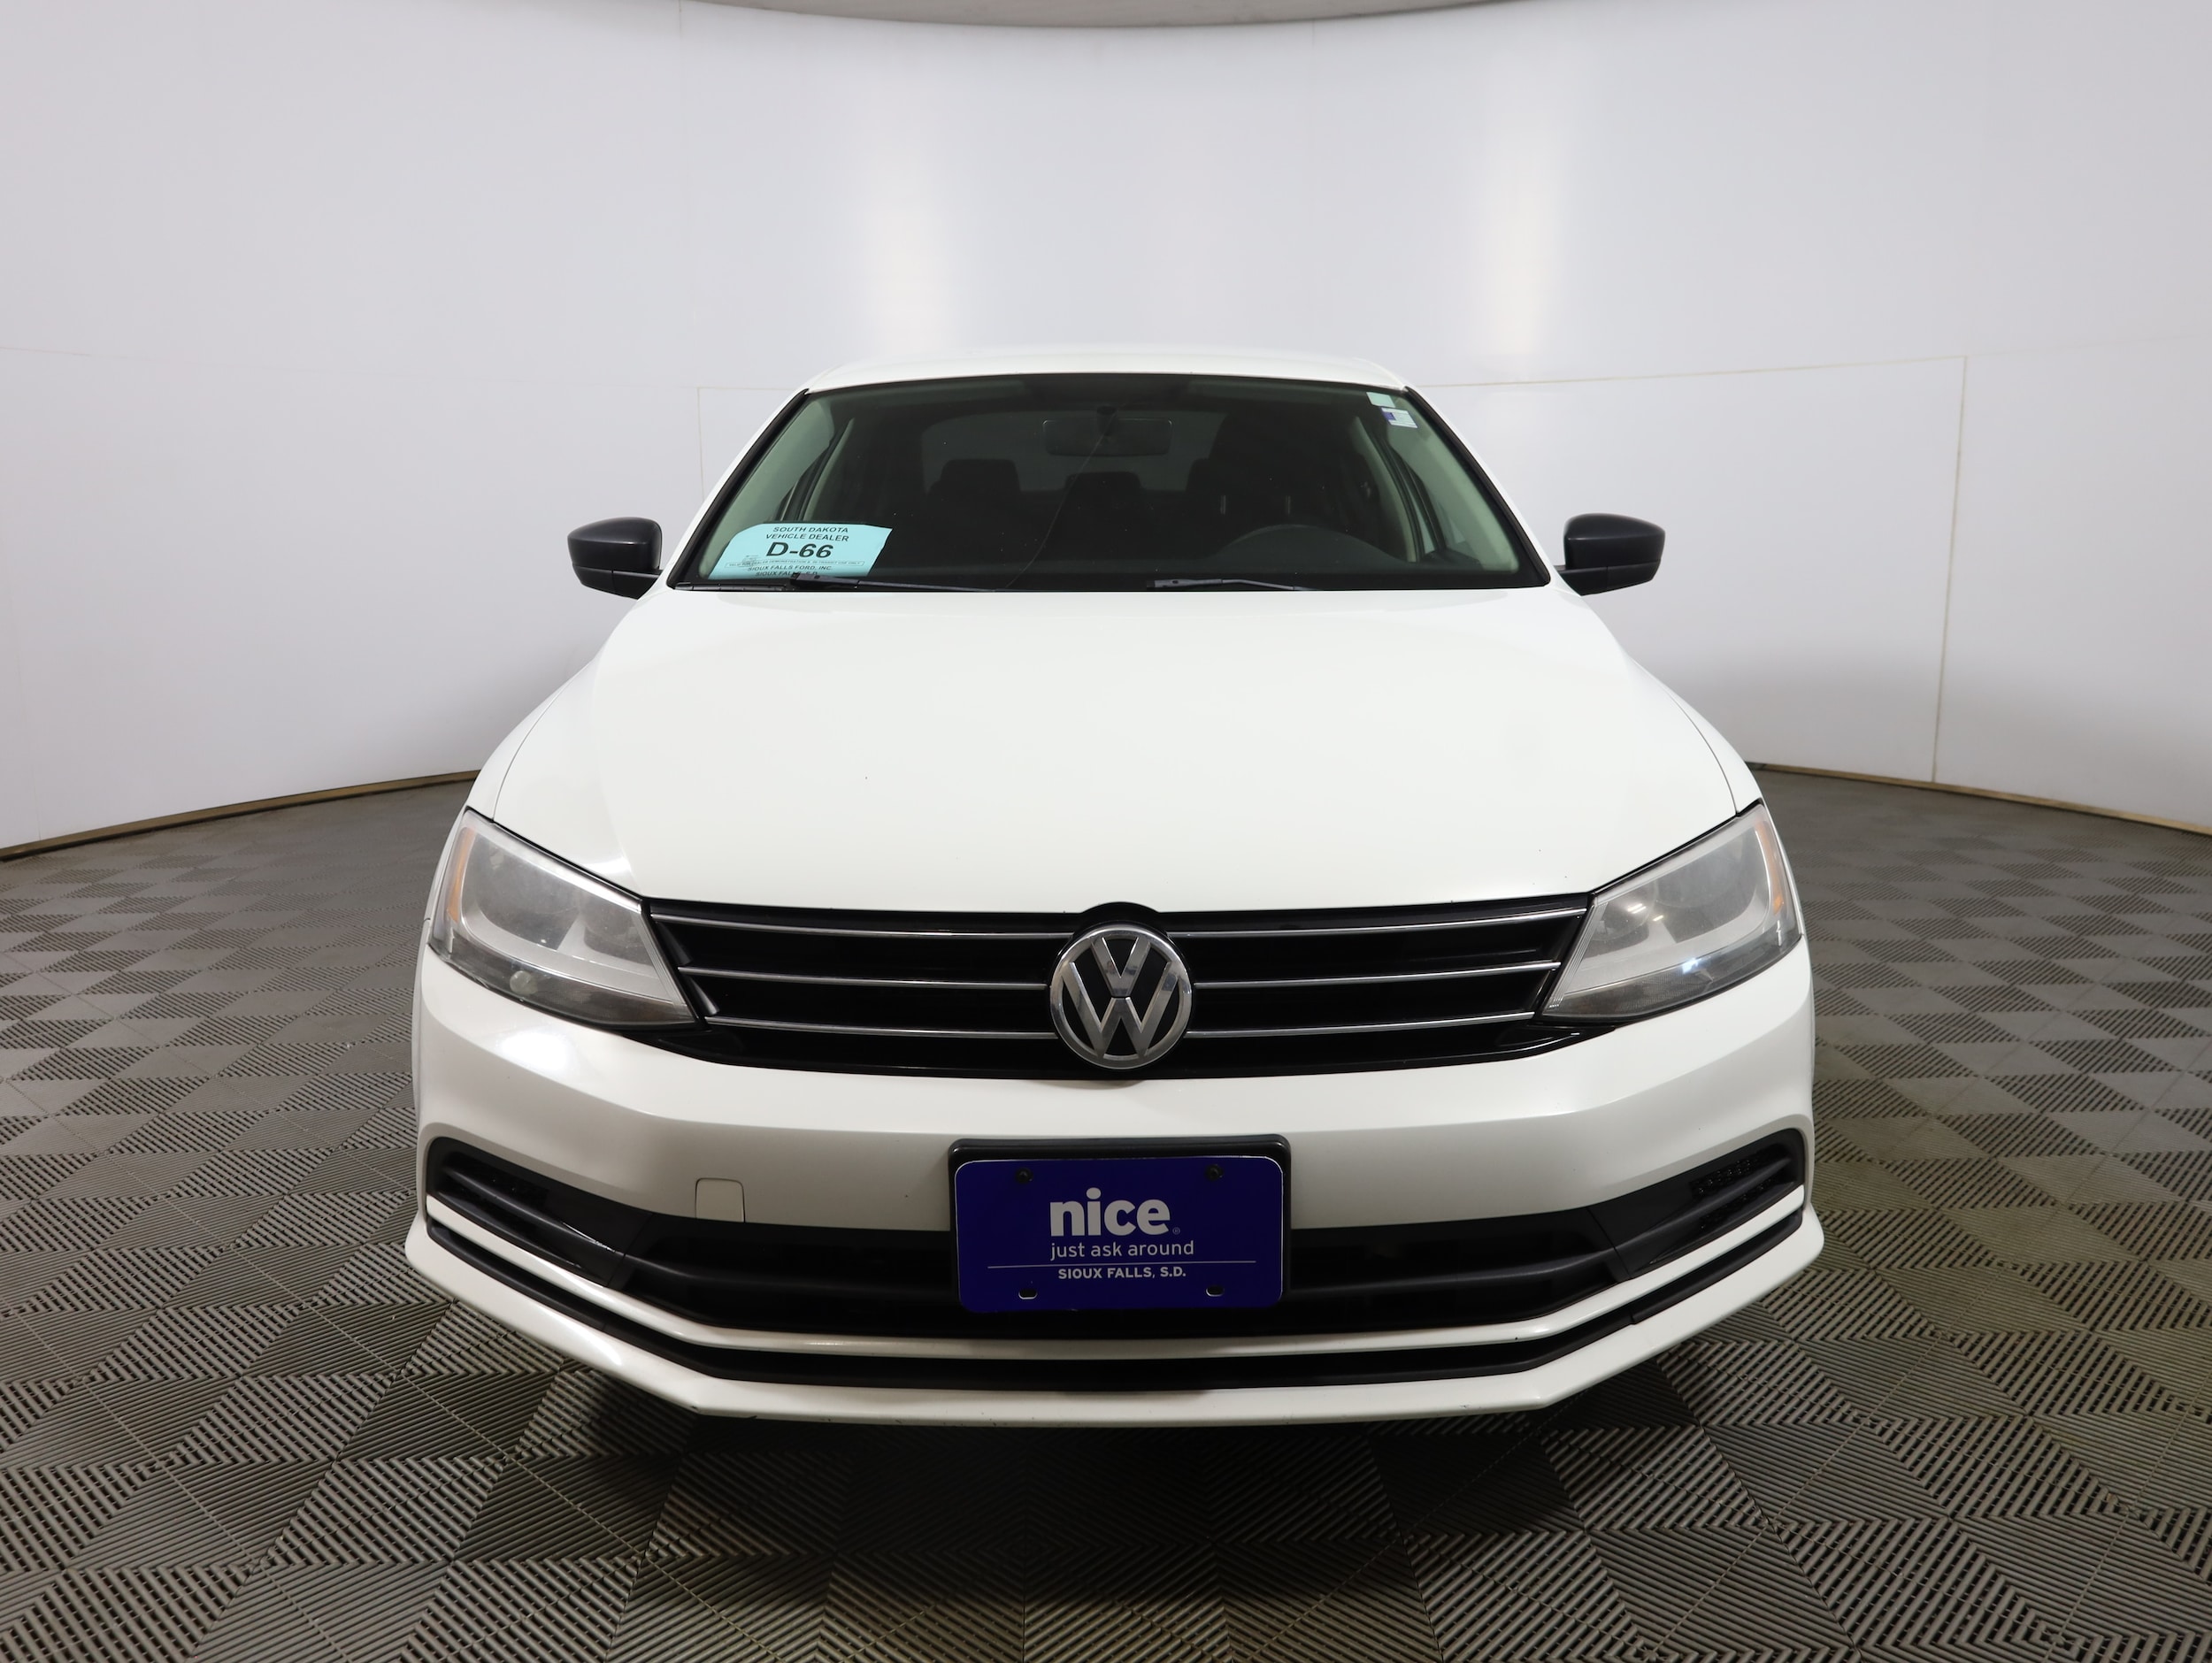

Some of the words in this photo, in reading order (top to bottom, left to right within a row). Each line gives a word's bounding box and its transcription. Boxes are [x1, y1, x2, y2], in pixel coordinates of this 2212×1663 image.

[765, 541, 833, 558] D-66
[1050, 1187, 1171, 1237] nice
[1050, 1242, 1085, 1261] just
[1091, 1241, 1122, 1257] ask
[1127, 1240, 1194, 1256] around
[1058, 1268, 1102, 1279] SIOUX
[1107, 1267, 1156, 1278] FALLS,
[1160, 1266, 1187, 1276] S.D.
